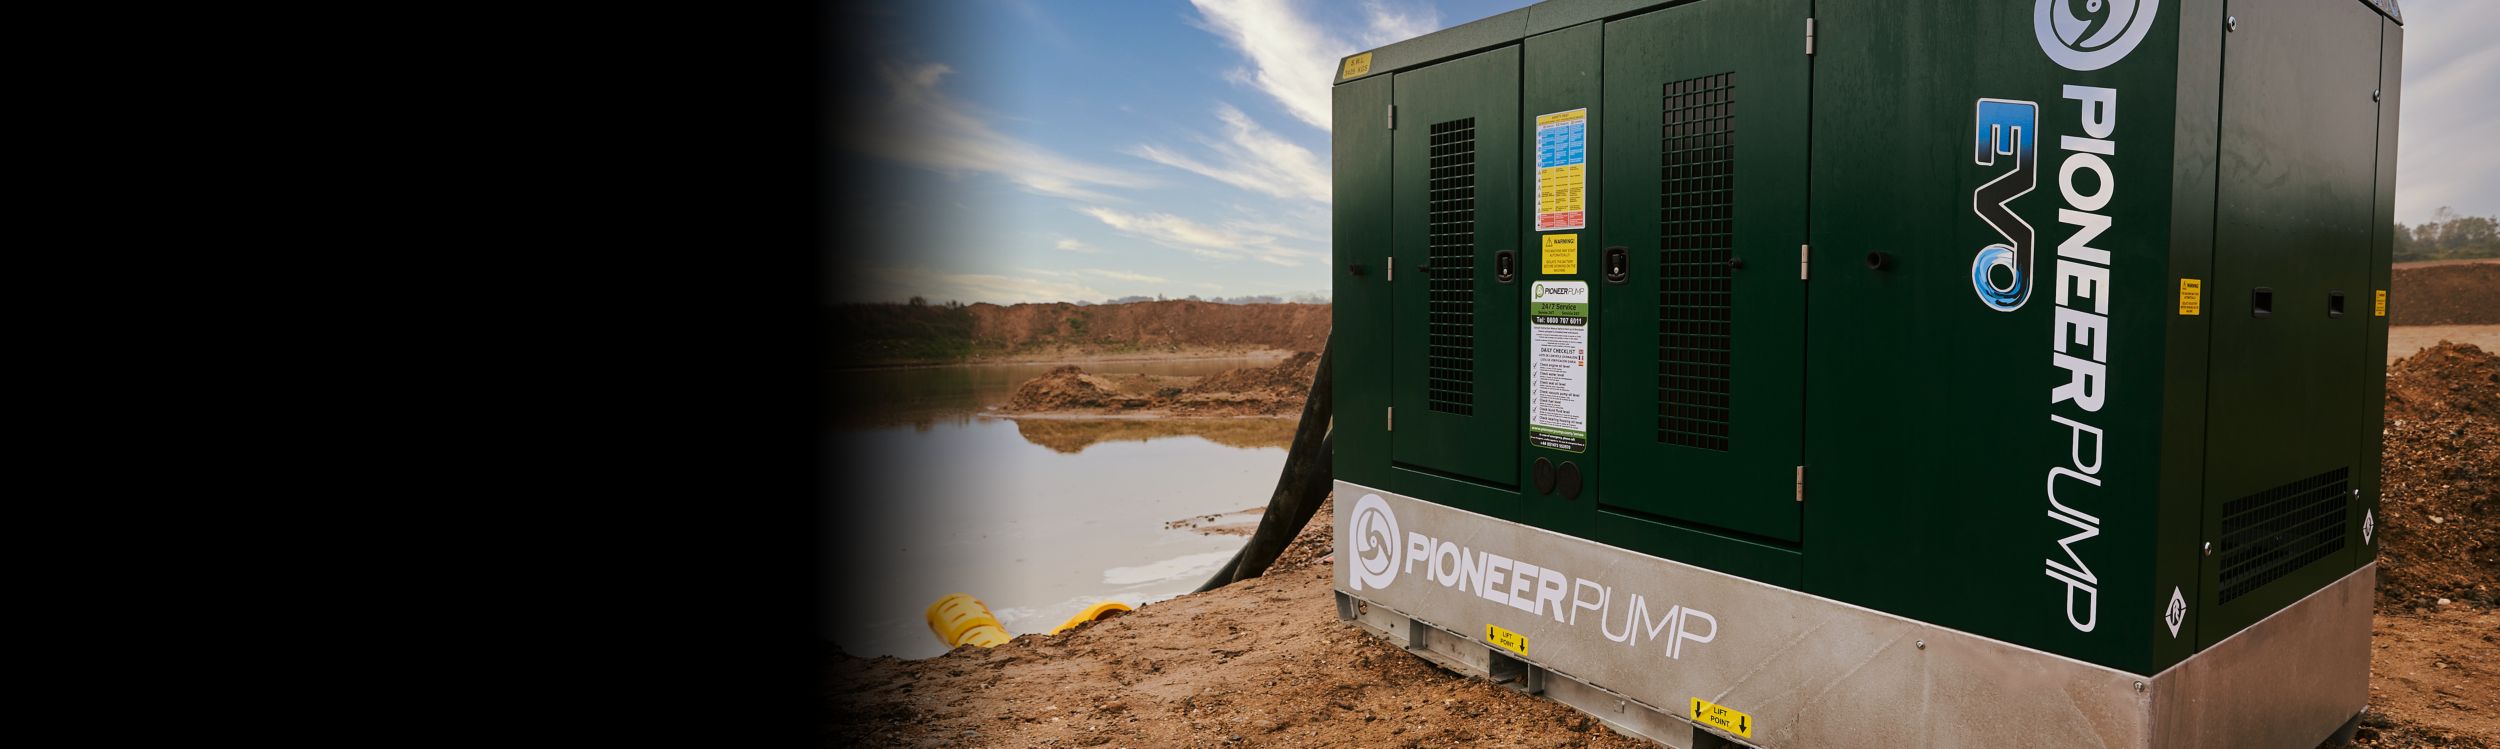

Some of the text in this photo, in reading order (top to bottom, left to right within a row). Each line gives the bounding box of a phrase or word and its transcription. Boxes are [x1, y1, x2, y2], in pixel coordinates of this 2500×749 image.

[1972, 98, 2039, 312] EVO
[1503, 631, 1512, 639] LIFT
[1500, 638, 1514, 648] POINT
[1713, 707, 1727, 717] LIFT
[1710, 715, 1730, 727] POINT
